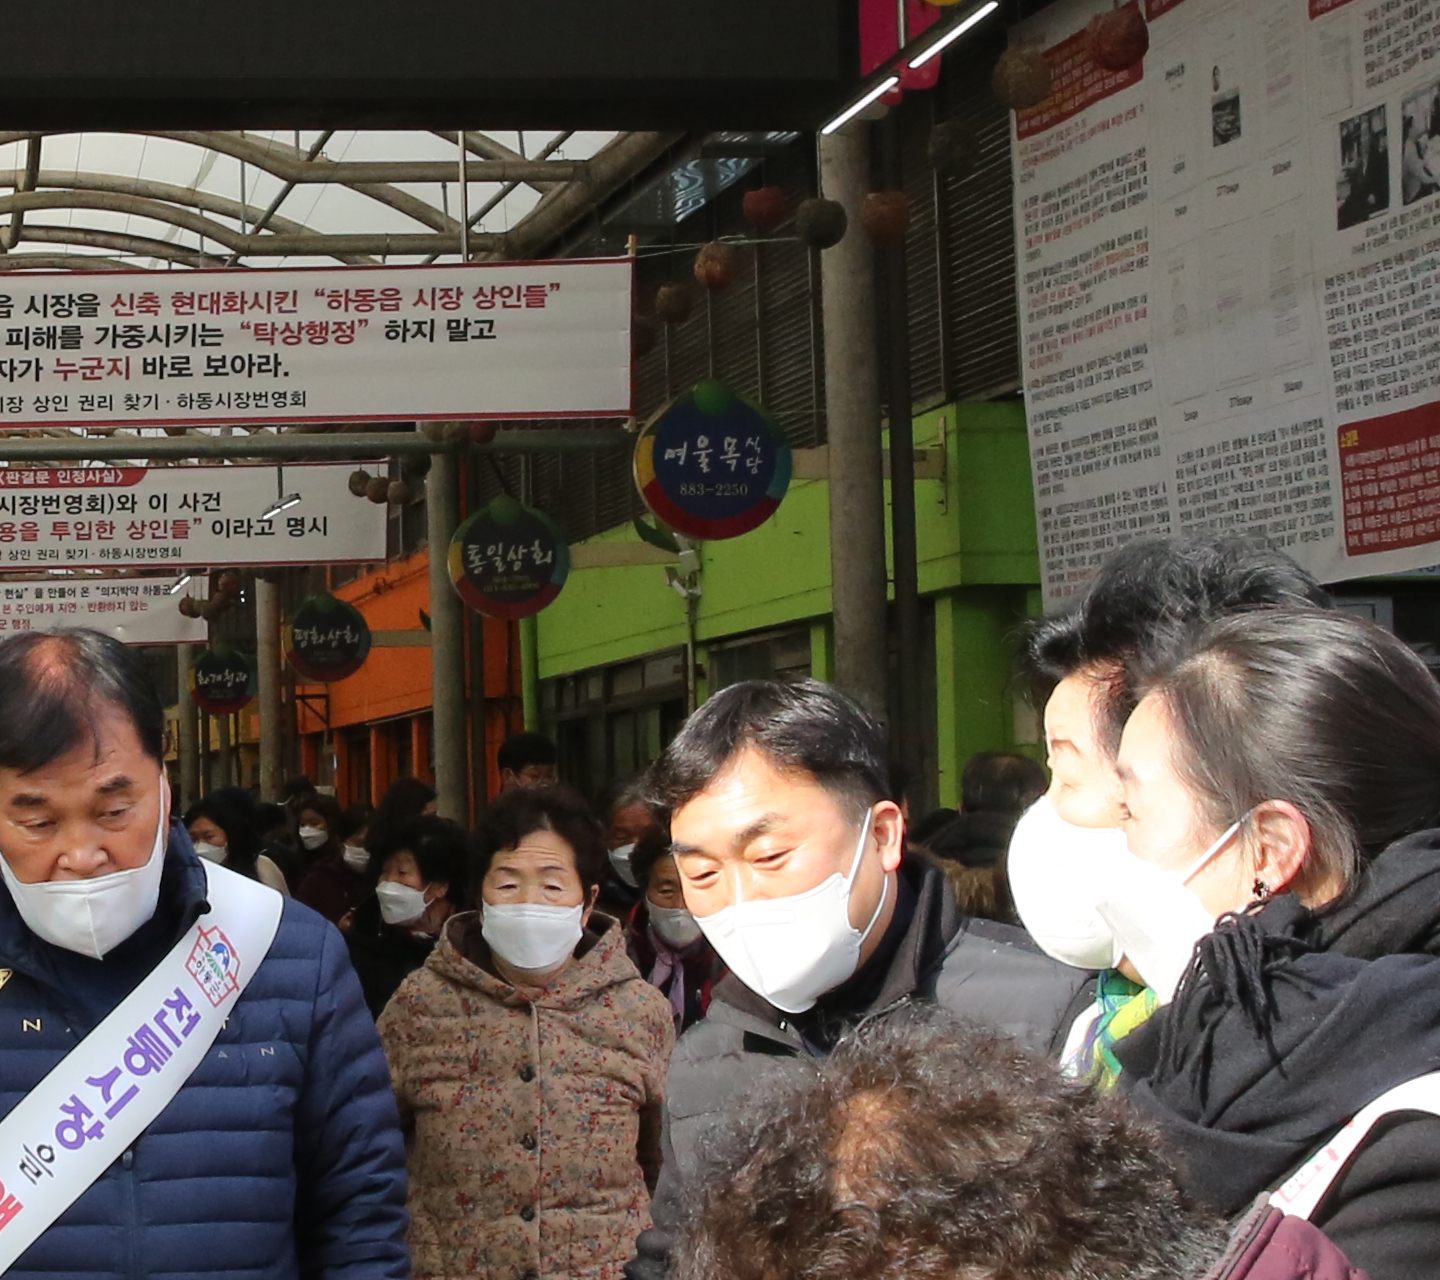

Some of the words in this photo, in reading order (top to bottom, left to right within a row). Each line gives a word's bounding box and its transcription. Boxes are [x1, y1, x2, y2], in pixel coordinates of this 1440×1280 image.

[24, 294, 100, 318] 시장을
[111, 292, 161, 317] 신축
[171, 291, 298, 315] 현대화시킨
[413, 287, 462, 311] 시장
[5, 325, 84, 350] 피해를
[94, 323, 224, 348] 가중시키는
[385, 319, 435, 342] 하지
[446, 318, 497, 341] 말고
[53, 356, 130, 382] 누군지
[142, 355, 193, 379] 바로
[203, 353, 289, 377] 보아라.
[33, 395, 68, 413] 상인
[78, 395, 113, 412] 권리
[124, 393, 159, 412] 찾기
[177, 391, 307, 409] 하동시장번영회
[148, 494, 168, 512] 이
[183, 492, 221, 512] 사건
[680, 484, 748, 496] 883-2250
[50, 520, 115, 541] 투입한
[212, 519, 274, 537] 이라고
[286, 517, 327, 536] 명시
